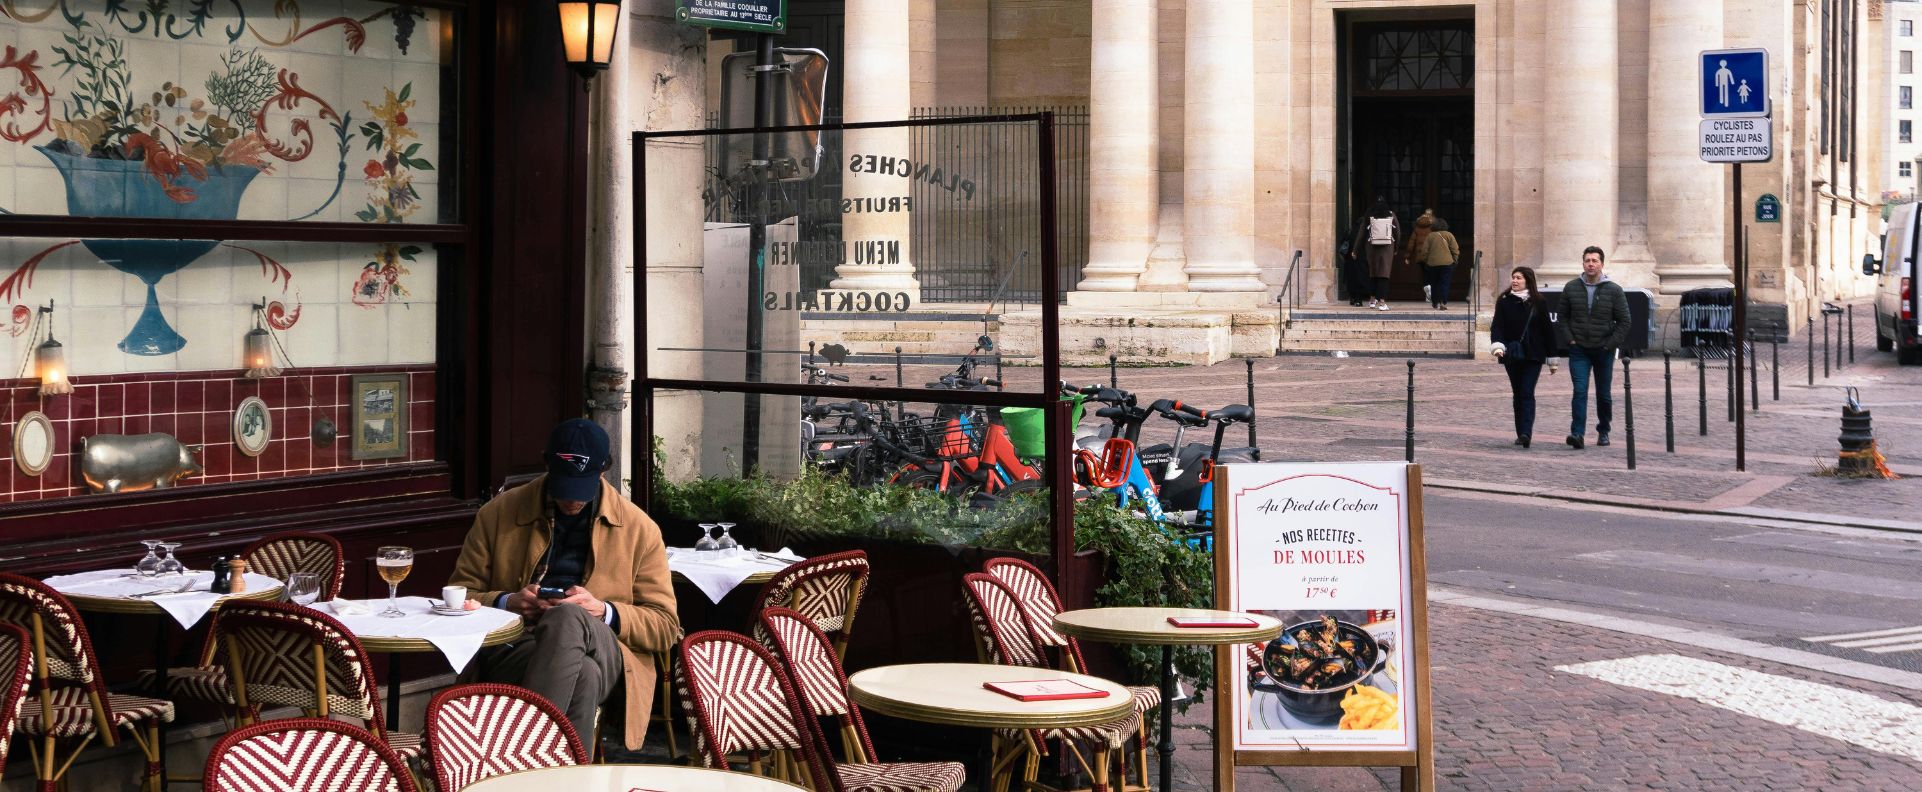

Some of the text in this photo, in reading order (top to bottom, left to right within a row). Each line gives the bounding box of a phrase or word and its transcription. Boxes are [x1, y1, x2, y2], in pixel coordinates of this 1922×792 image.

[714, 1, 736, 10] FAMILLE
[1713, 120, 1754, 131] CYCLISTES
[1705, 133, 1763, 144] ROULEZ AU PAS
[1701, 146, 1768, 156] PRIORITE PIETONS
[1256, 496, 1379, 515] Au Pied de Cochon
[1282, 528, 1355, 545] NOS RECETTES
[1273, 549, 1365, 565] DE MOULES
[1307, 575, 1329, 584] partir
[1330, 575, 1339, 583] de
